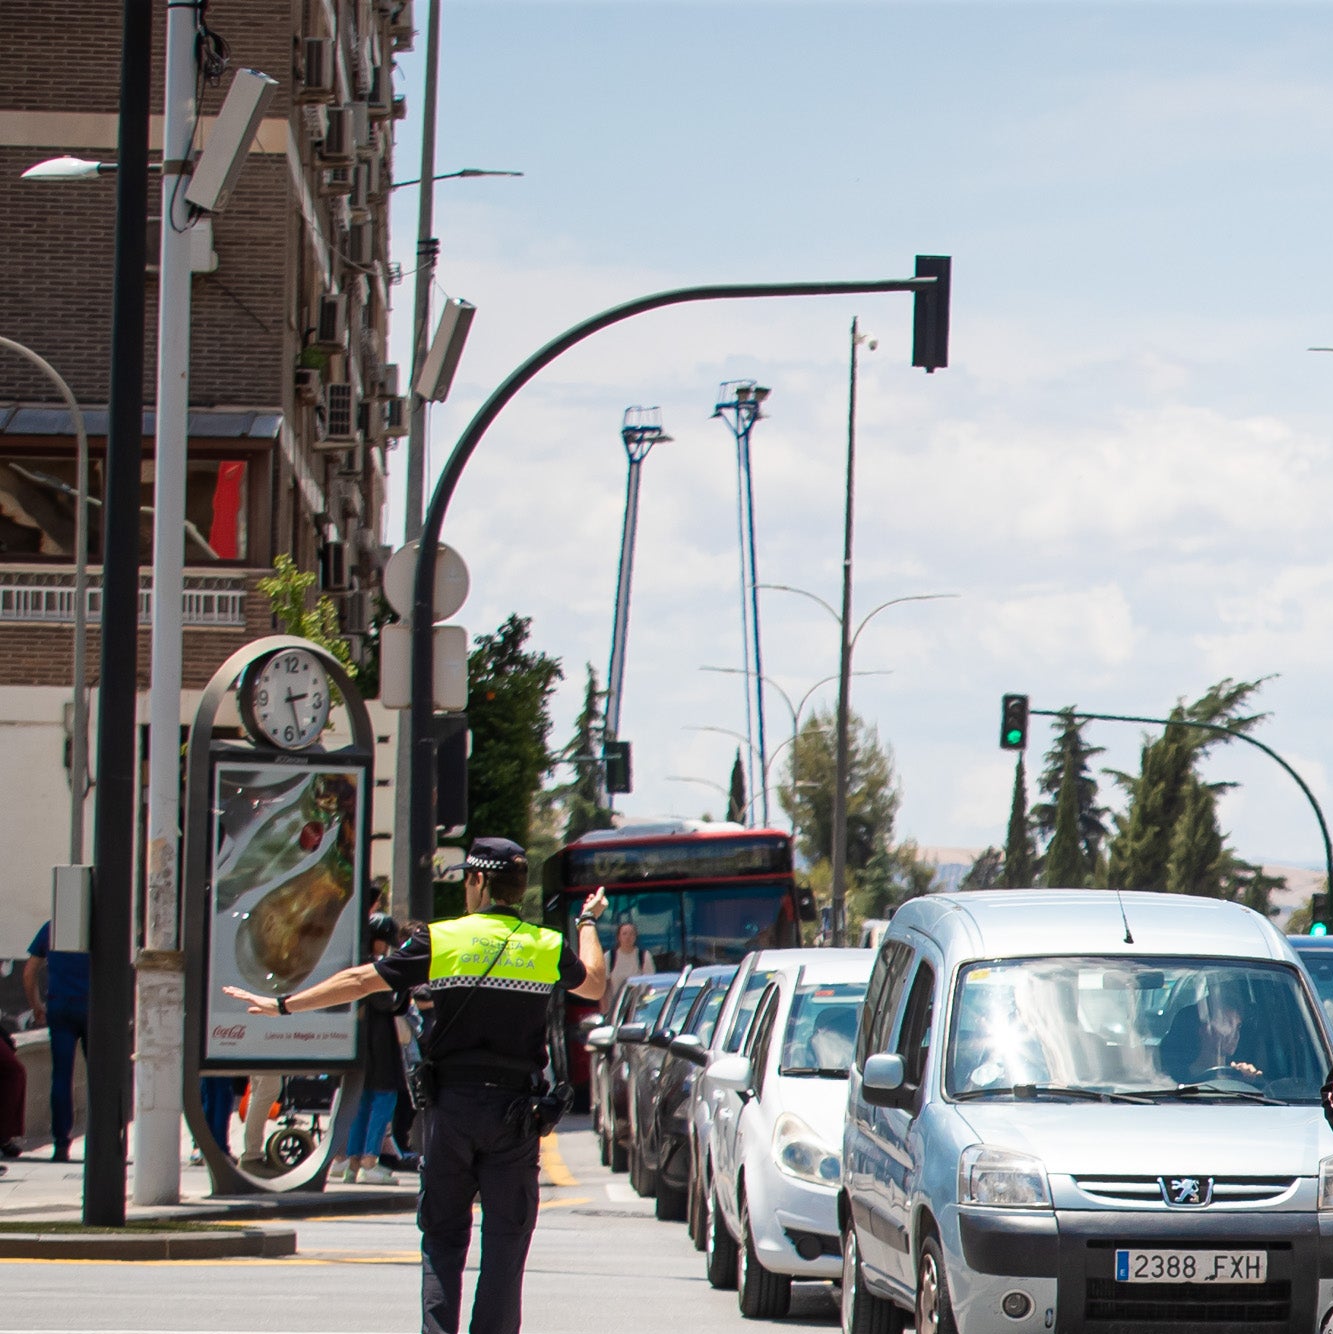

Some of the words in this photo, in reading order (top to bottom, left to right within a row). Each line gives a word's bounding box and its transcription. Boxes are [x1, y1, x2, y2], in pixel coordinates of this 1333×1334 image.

[284, 656, 299, 673] 12
[258, 689, 269, 707] 9
[312, 692, 322, 709] 3
[284, 725, 294, 742] 6
[1134, 1254, 1197, 1279] 2388
[1213, 1255, 1260, 1279] FXH
